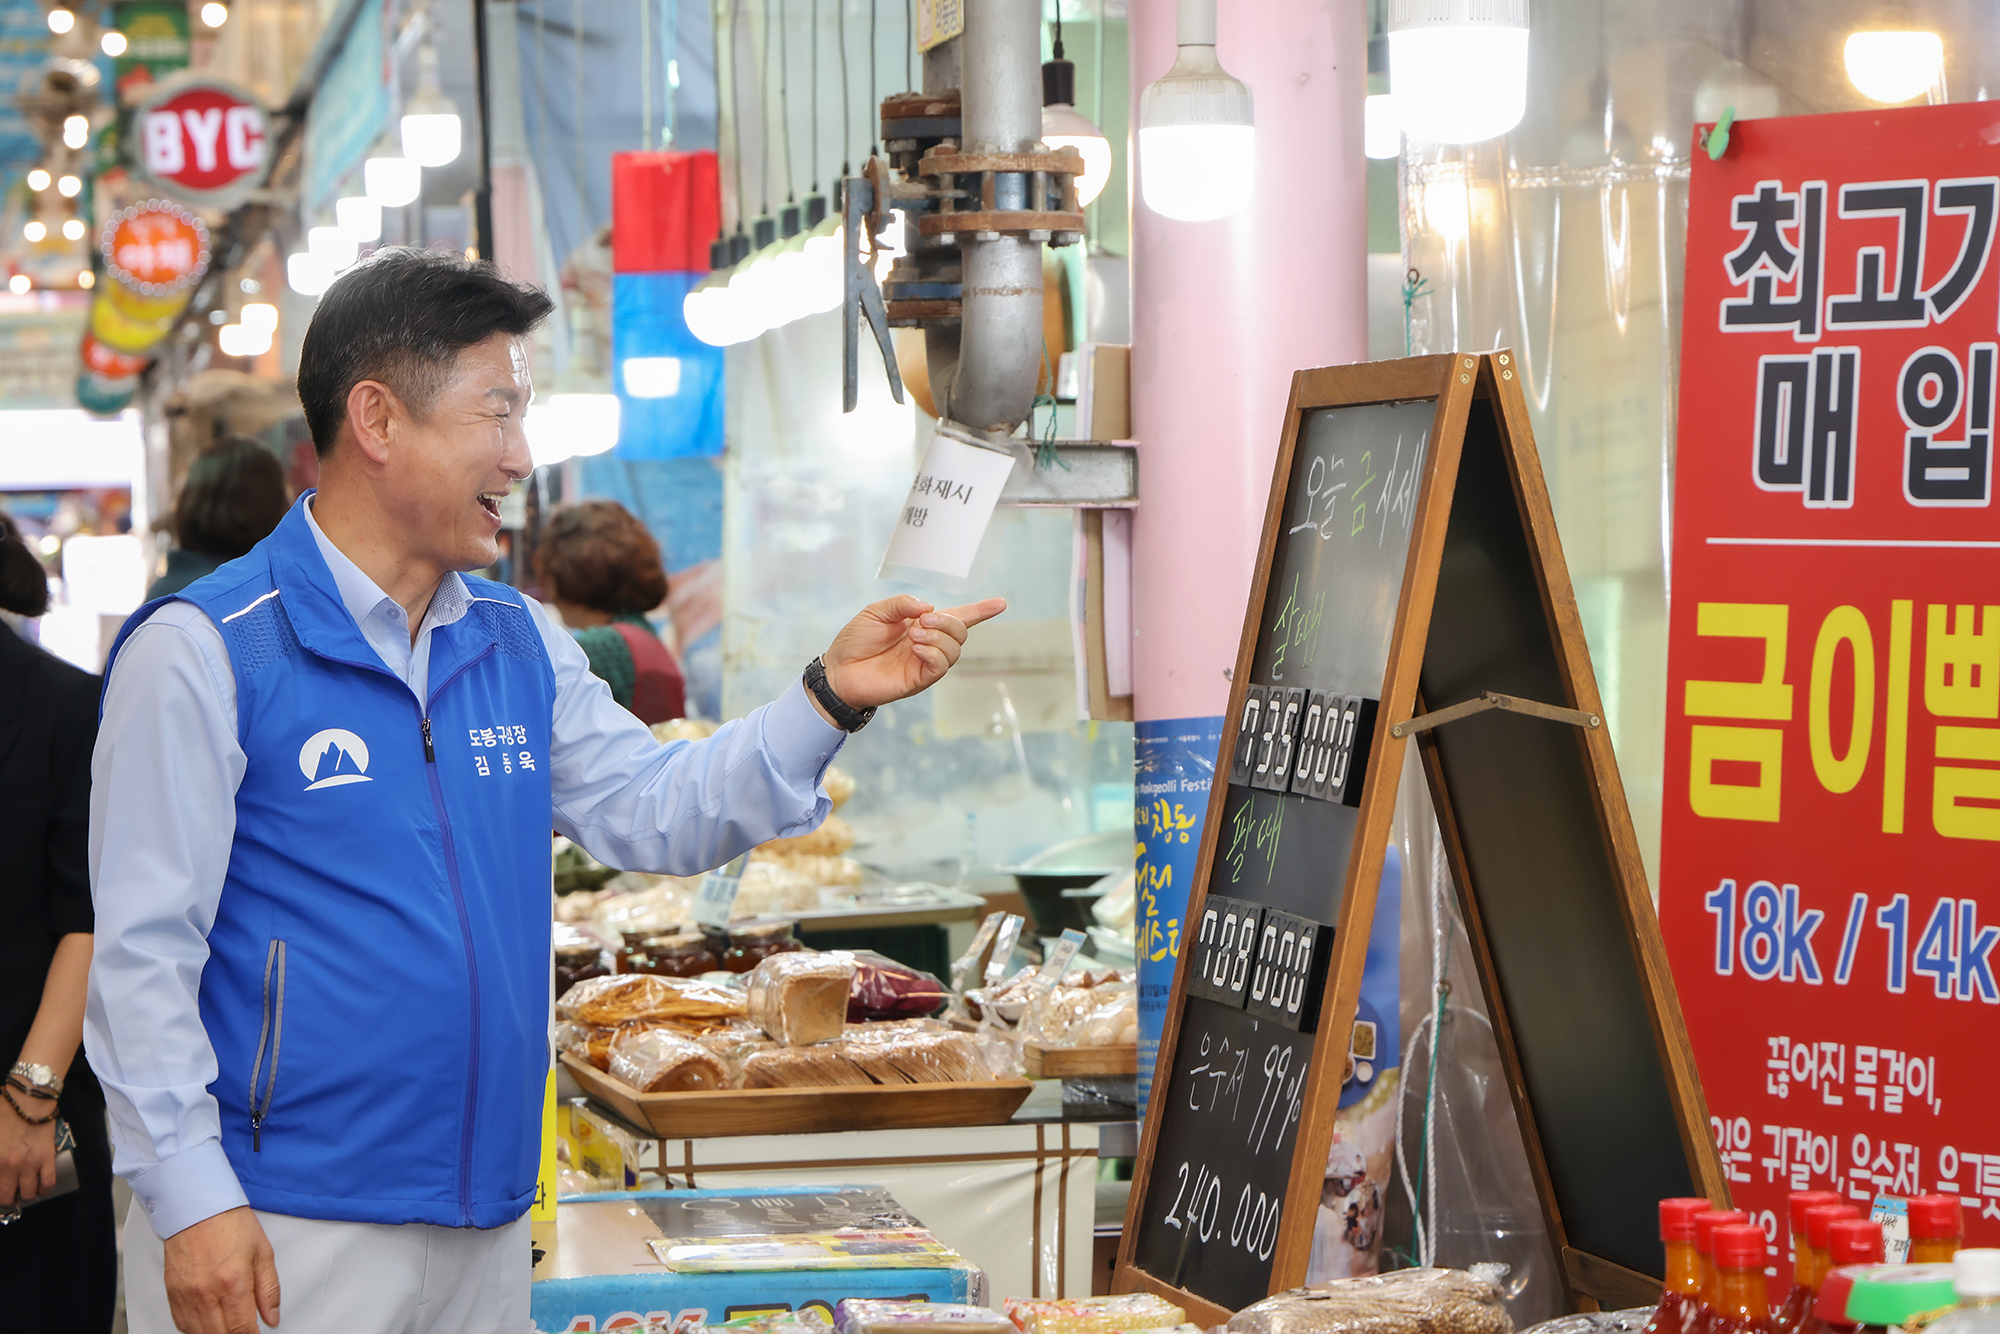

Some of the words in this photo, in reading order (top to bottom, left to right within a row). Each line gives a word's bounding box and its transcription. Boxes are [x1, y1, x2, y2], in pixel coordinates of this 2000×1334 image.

[145, 105, 265, 175] BYC
[1289, 454, 1348, 540] 오늘
[1350, 450, 1377, 538] 금
[1375, 430, 1427, 550] 시세
[1152, 798, 1197, 844] 창동
[1705, 878, 1825, 985] 18k
[1876, 893, 2000, 1004] 14k
[1189, 1032, 1250, 1122] 은수저
[1247, 1044, 1307, 1155] 99%
[1767, 1036, 1845, 1106] 끊어진
[1854, 1045, 1942, 1116] 목걸이,
[1164, 1161, 1280, 1262] 240.000
